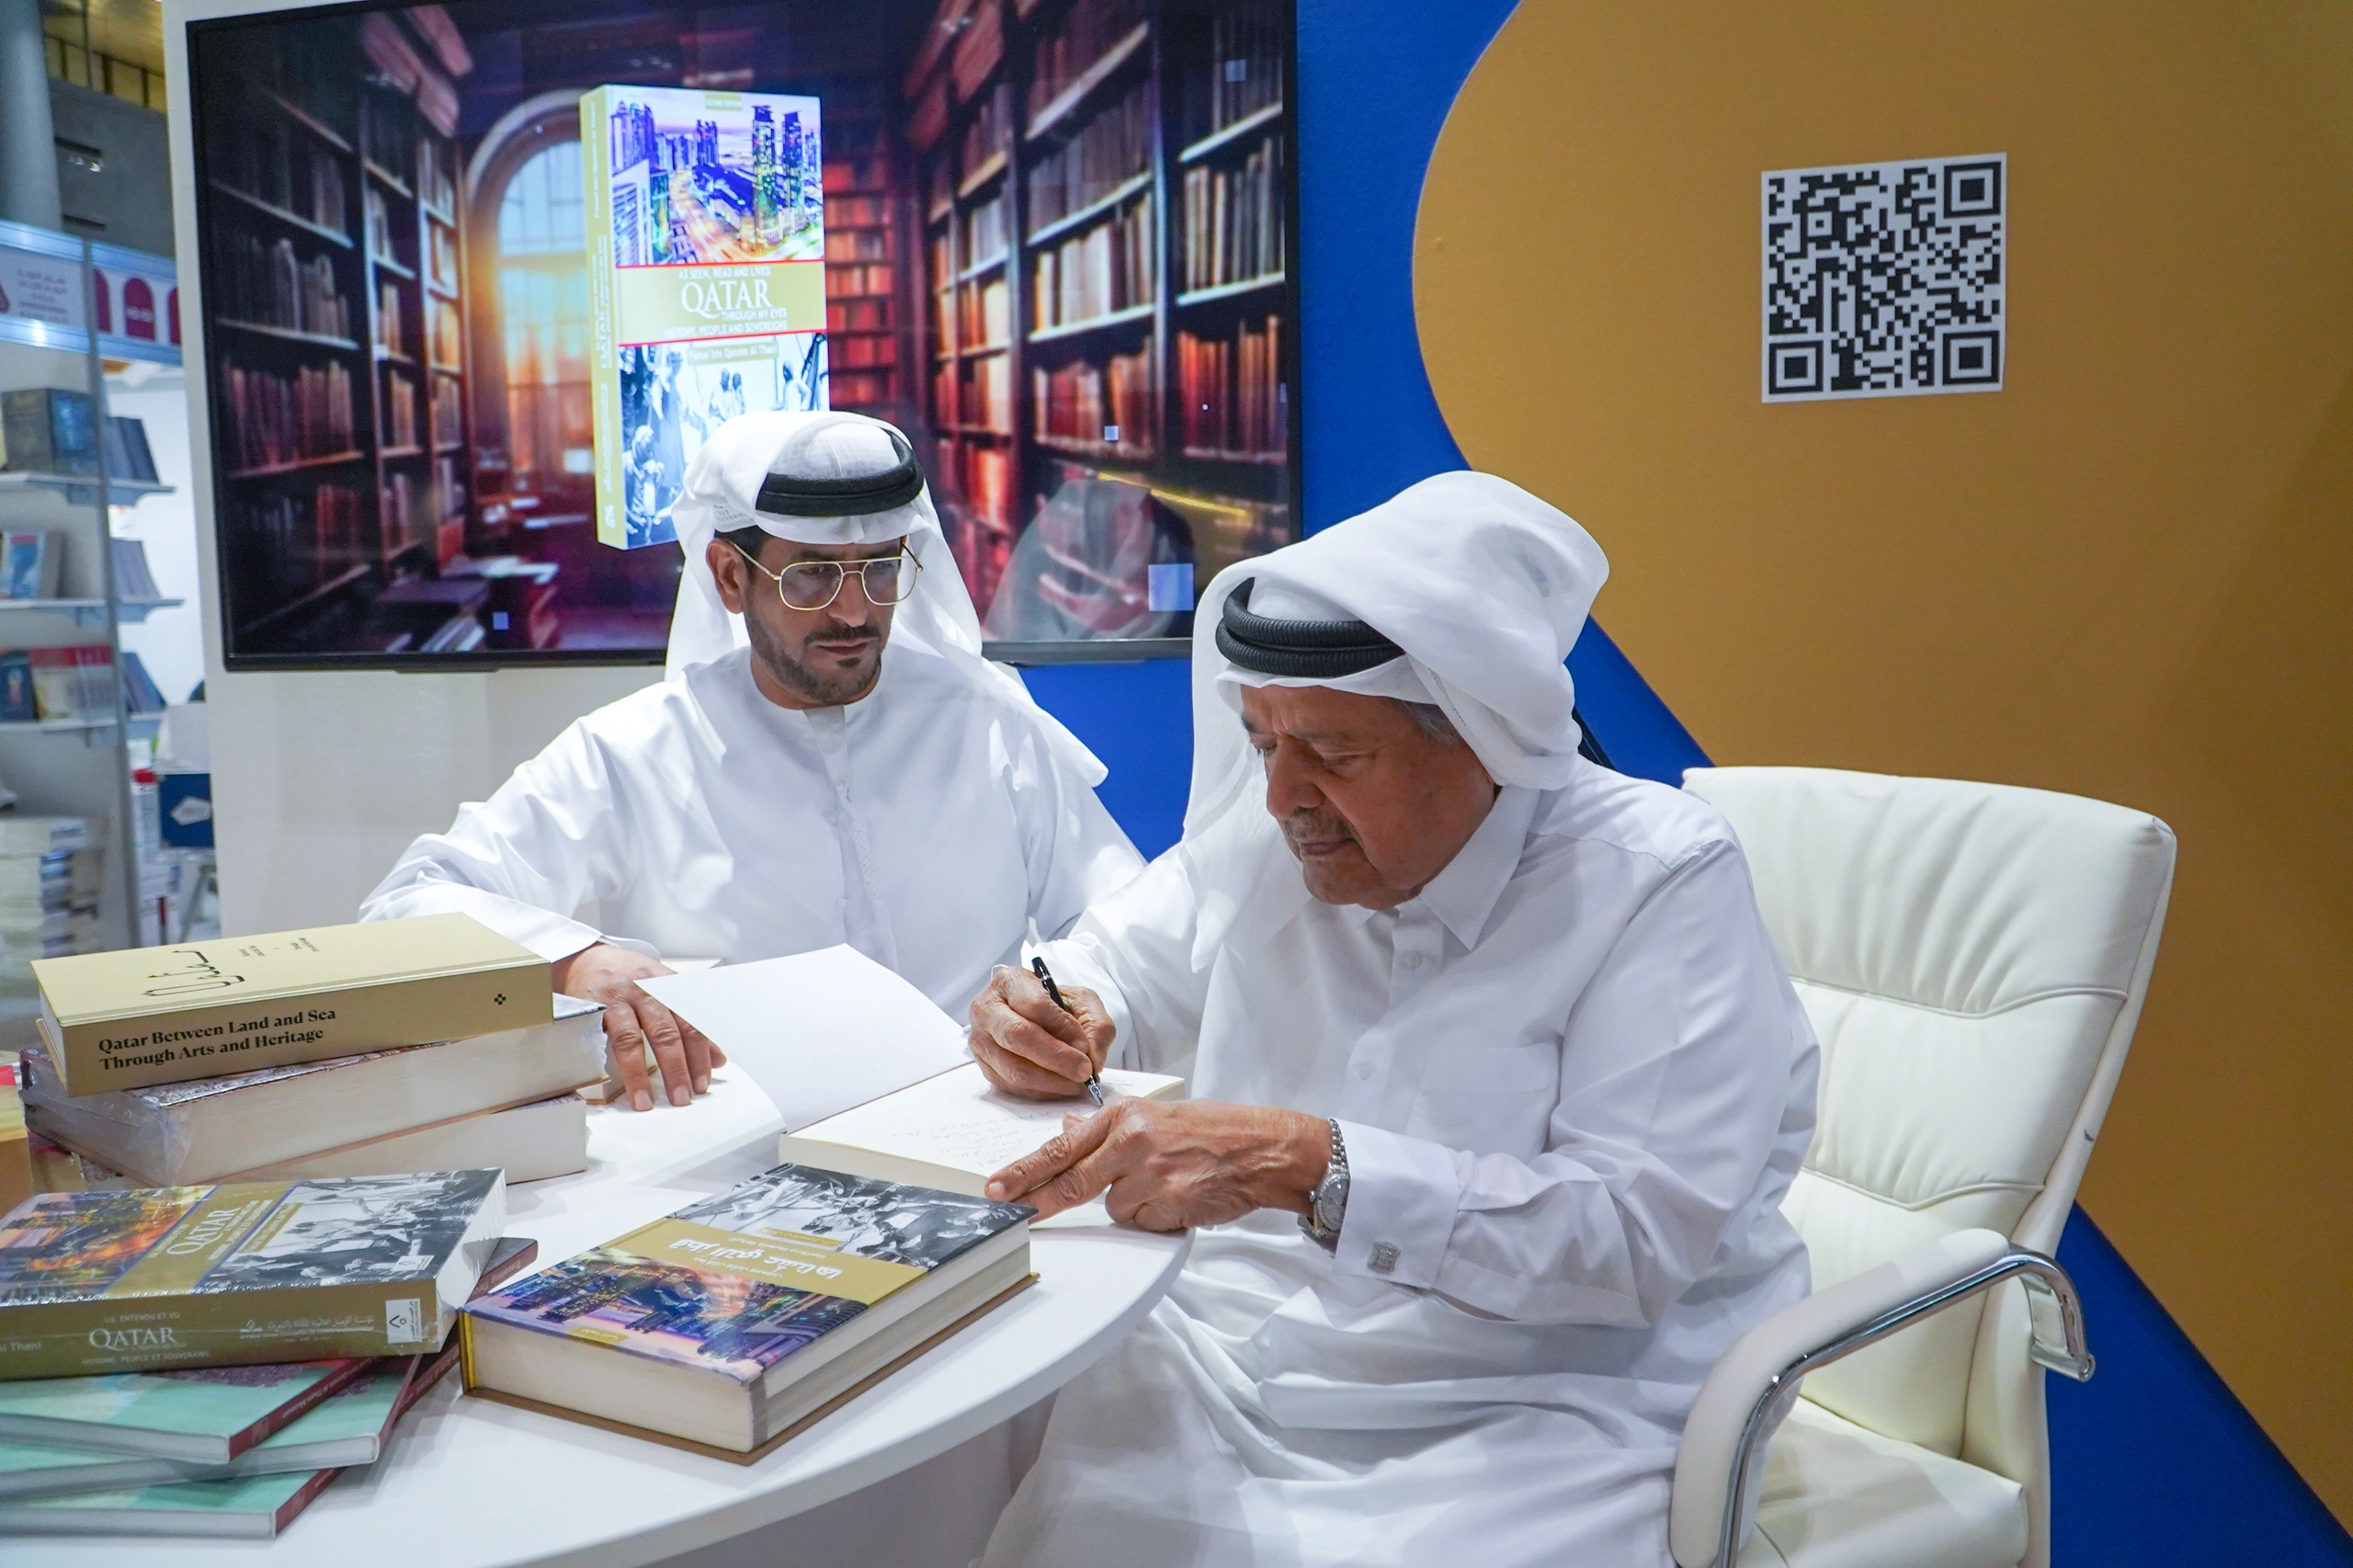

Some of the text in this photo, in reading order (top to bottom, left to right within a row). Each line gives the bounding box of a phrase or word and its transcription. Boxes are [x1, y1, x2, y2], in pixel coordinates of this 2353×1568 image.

[750, 265, 771, 277] LIVED
[680, 278, 774, 320] QATAR
[770, 307, 788, 319] EYES
[98, 1009, 336, 1054] Qatar Between Land and Sea
[99, 1028, 324, 1071] Through Arts and Heritage
[165, 1207, 243, 1256] QATAR
[89, 1326, 177, 1352] QATAR
